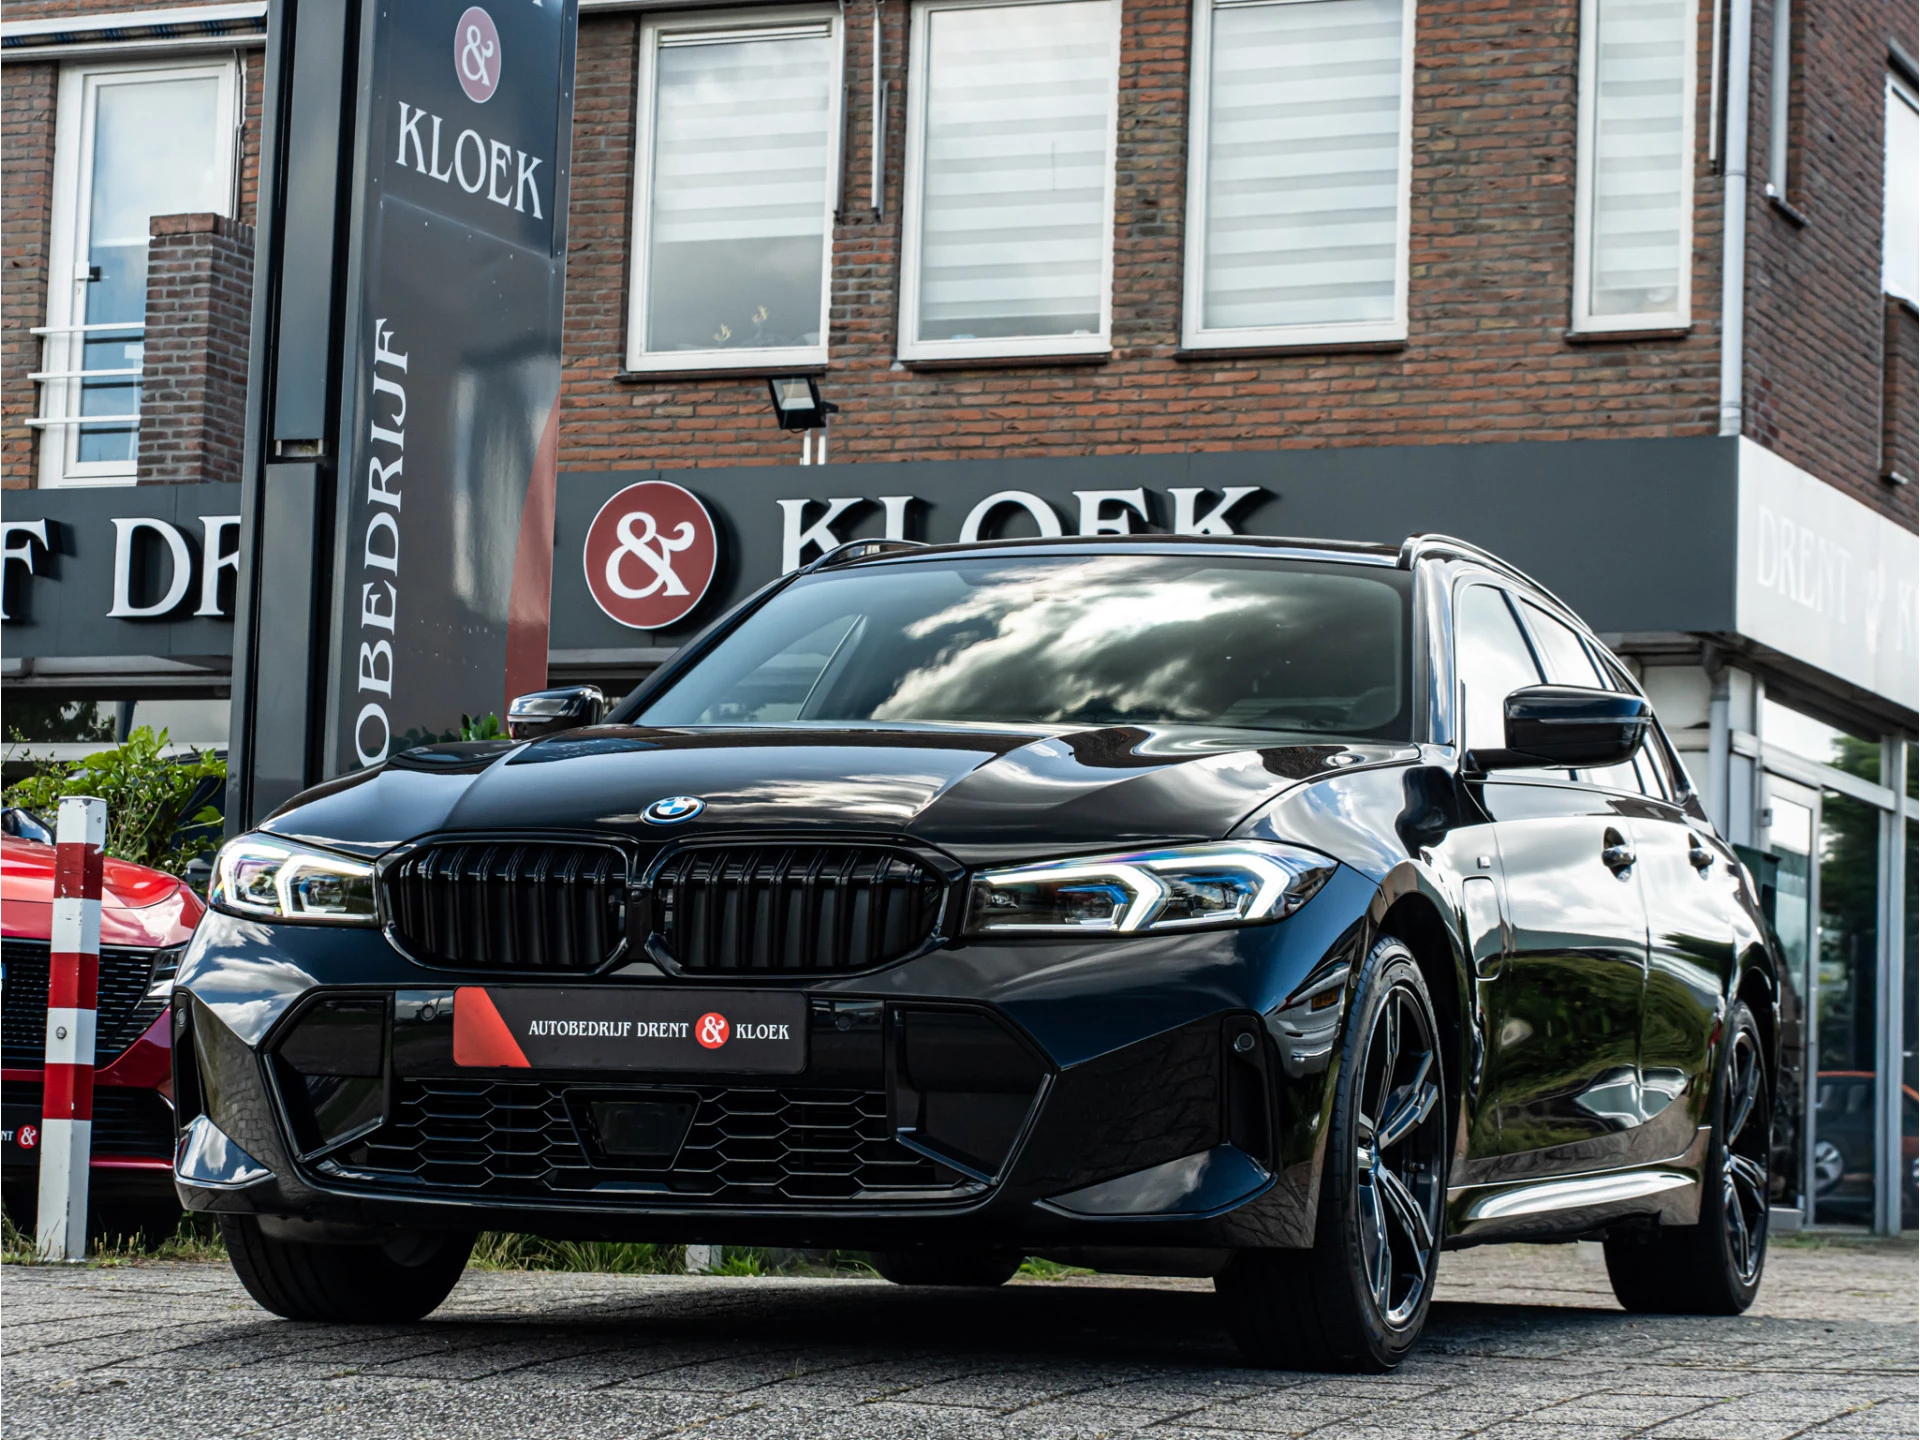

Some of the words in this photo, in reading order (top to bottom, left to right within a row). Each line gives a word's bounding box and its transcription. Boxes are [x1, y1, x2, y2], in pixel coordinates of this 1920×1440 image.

[462, 25, 494, 87] &
[395, 101, 543, 220] KLOEK
[355, 318, 408, 768] OBEDRIJF
[605, 511, 695, 599] &
[1756, 504, 1853, 624] DRENT
[528, 1020, 631, 1037] AUTOBEDRIJF
[637, 1021, 689, 1038] DRENT
[701, 1016, 725, 1043] &
[736, 1023, 790, 1040] KLOEK
[20, 1126, 37, 1146] &
